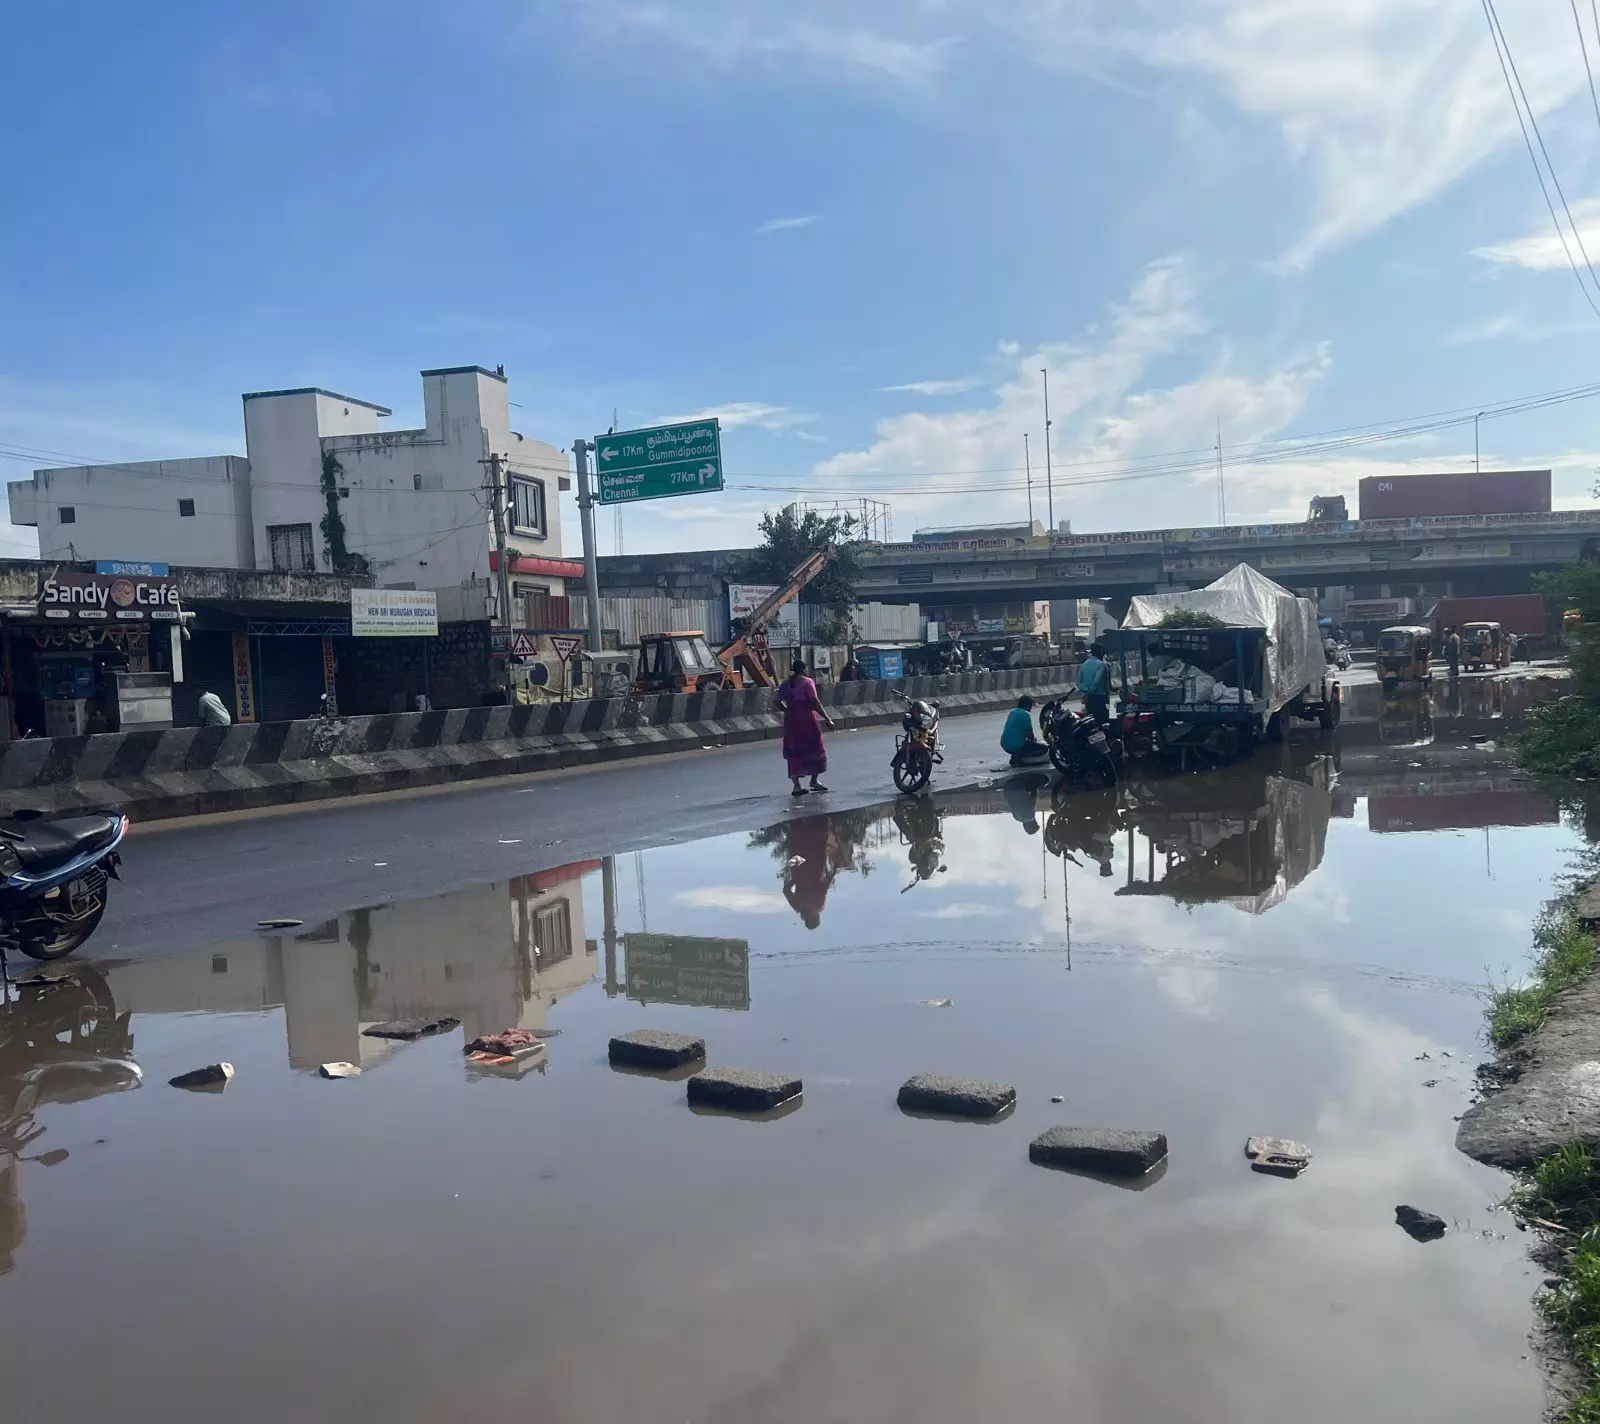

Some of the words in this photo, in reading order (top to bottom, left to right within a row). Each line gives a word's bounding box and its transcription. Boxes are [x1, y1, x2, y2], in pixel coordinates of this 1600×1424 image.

[622, 446, 644, 457] 17Km
[648, 442, 716, 461] Gummidipoondi
[602, 473, 645, 487] சென்னை
[670, 472, 696, 484] 27Km
[603, 486, 639, 500] Chennai
[44, 580, 109, 608] Sandy
[136, 584, 179, 604] Café
[367, 607, 379, 616] NEW
[390, 608, 413, 616] MURUGAN
[414, 608, 436, 617] MEDICALS
